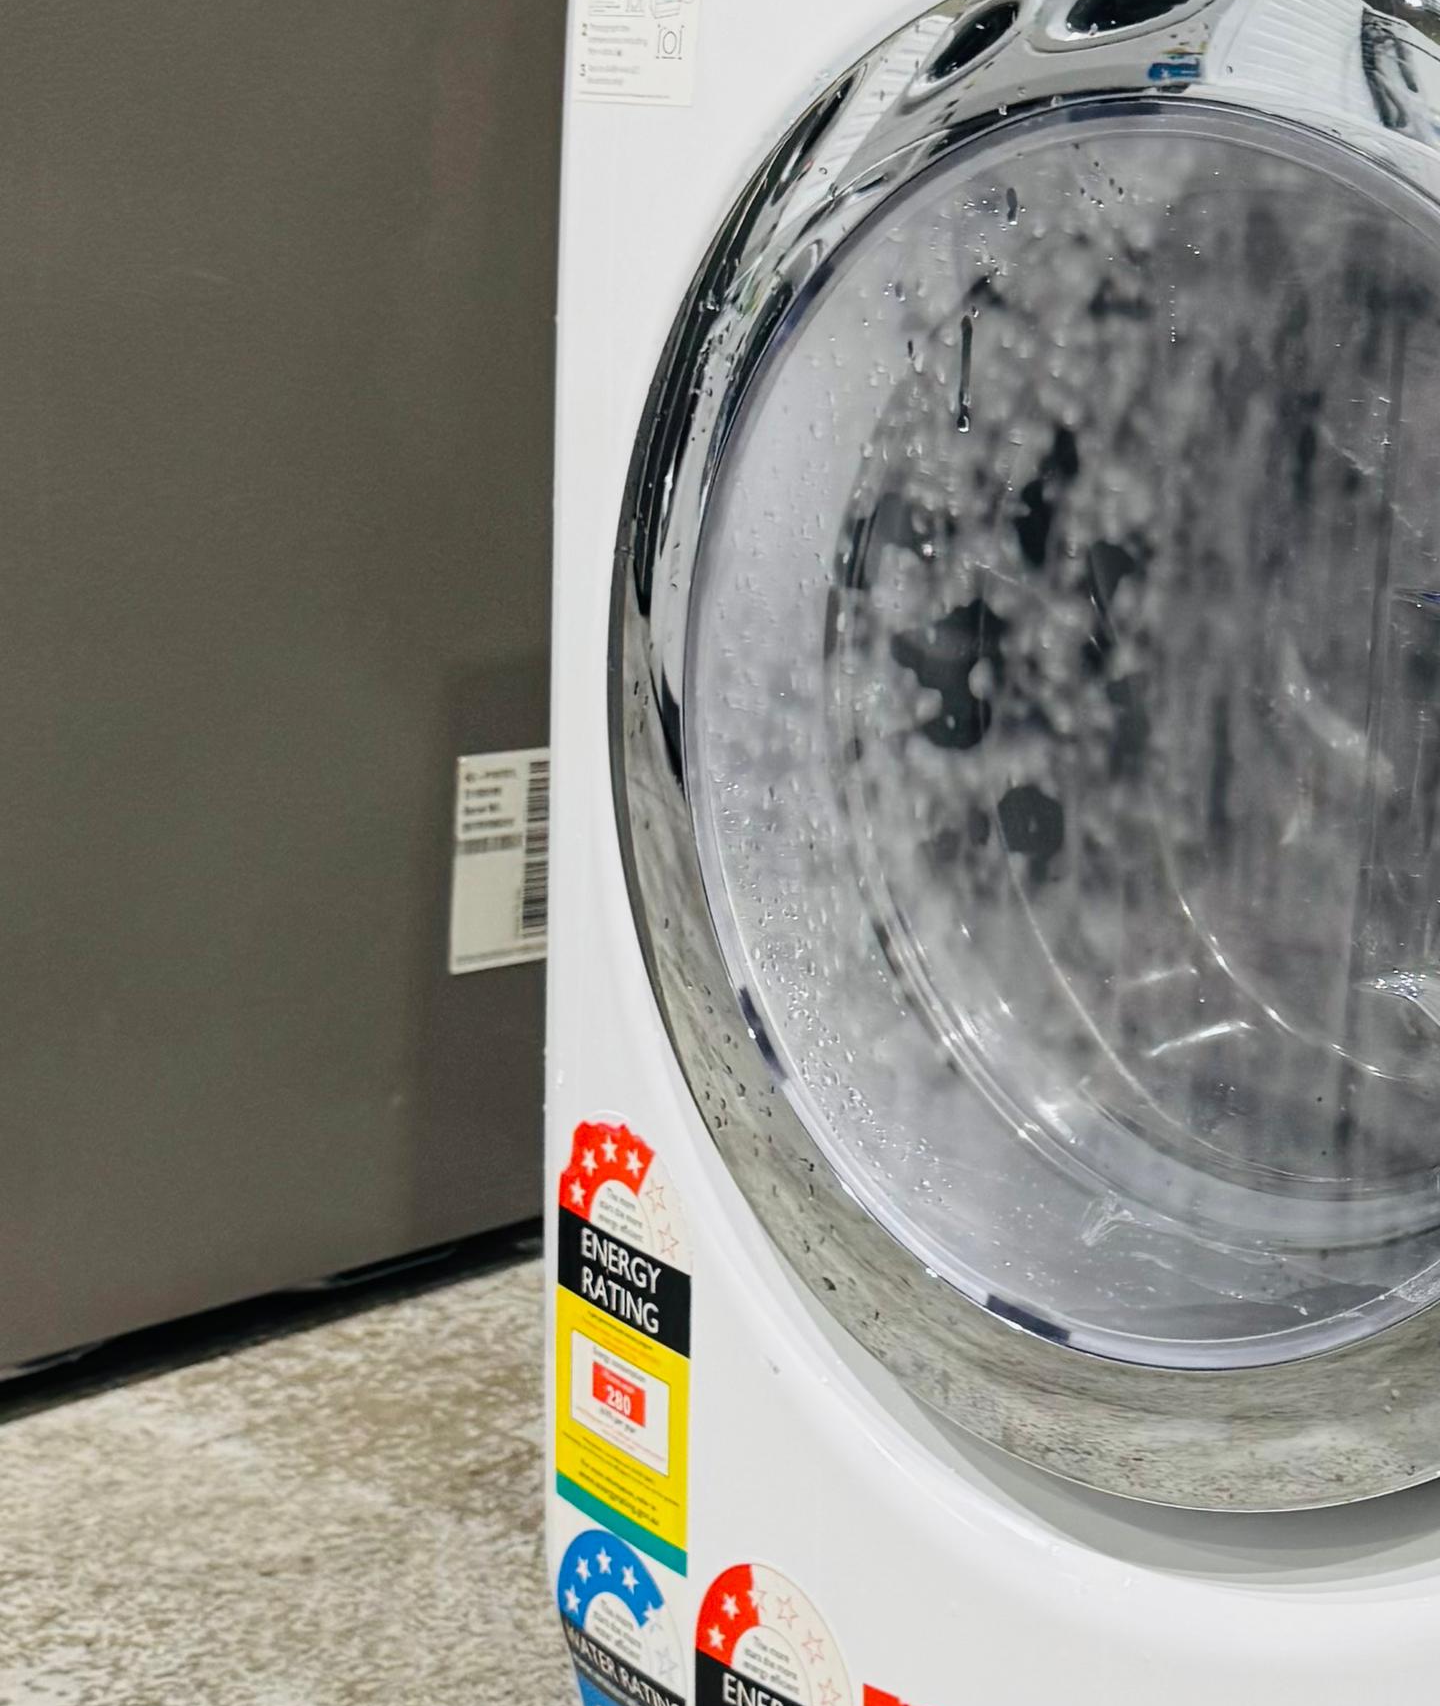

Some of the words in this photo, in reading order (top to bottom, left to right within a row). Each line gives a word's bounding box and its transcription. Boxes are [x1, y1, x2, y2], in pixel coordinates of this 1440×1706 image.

[581, 1227, 661, 1294] ENERGY
[581, 1265, 659, 1334] RATING
[606, 1384, 631, 1416] 280
